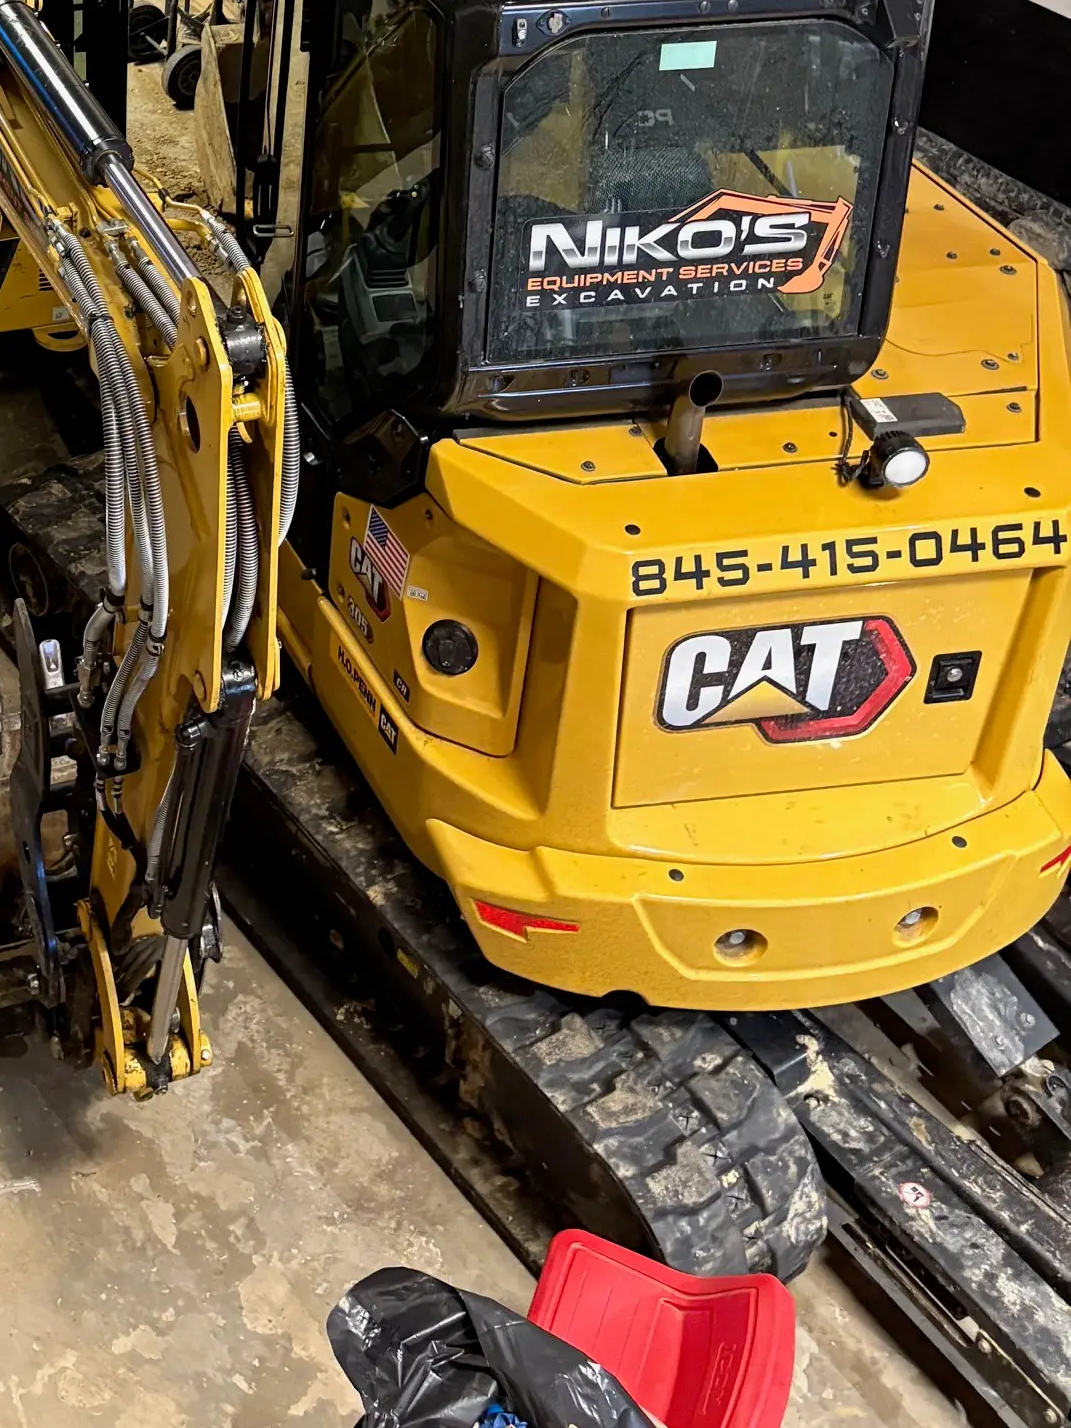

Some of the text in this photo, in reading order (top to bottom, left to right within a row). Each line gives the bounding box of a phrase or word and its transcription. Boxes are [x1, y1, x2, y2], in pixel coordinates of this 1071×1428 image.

[528, 213, 810, 272] NIKO'S
[526, 277, 775, 308] EXCAVATION
[527, 257, 804, 291] EQUIPMENT SERVICES
[350, 538, 383, 605] CAT
[631, 518, 1068, 597] 845-415-0464
[348, 595, 369, 638] 305
[661, 619, 864, 727] CAT
[380, 713, 396, 744] CAT
